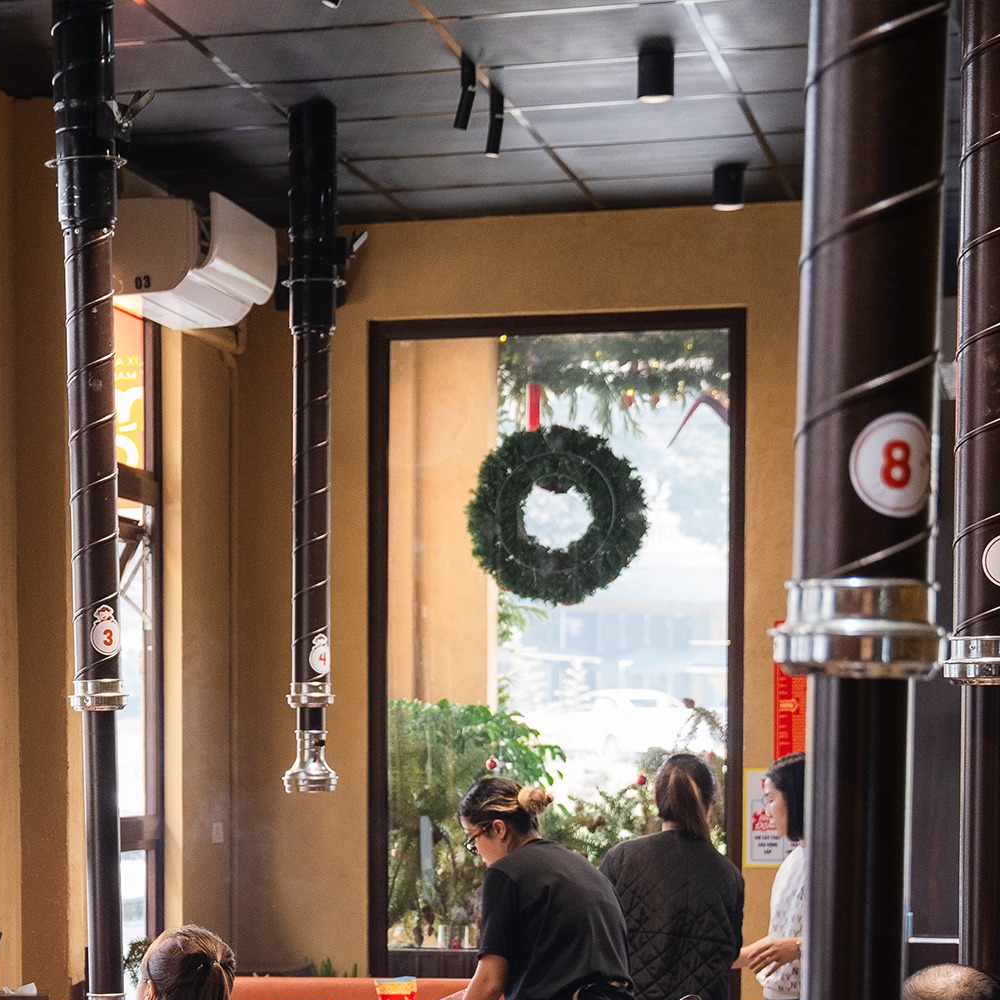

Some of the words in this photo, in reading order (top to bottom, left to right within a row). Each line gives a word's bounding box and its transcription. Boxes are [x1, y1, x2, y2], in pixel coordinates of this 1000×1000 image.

[134, 275, 151, 290] 03
[880, 439, 911, 490] 8
[103, 629, 113, 646] 3
[318, 652, 327, 666] 4
